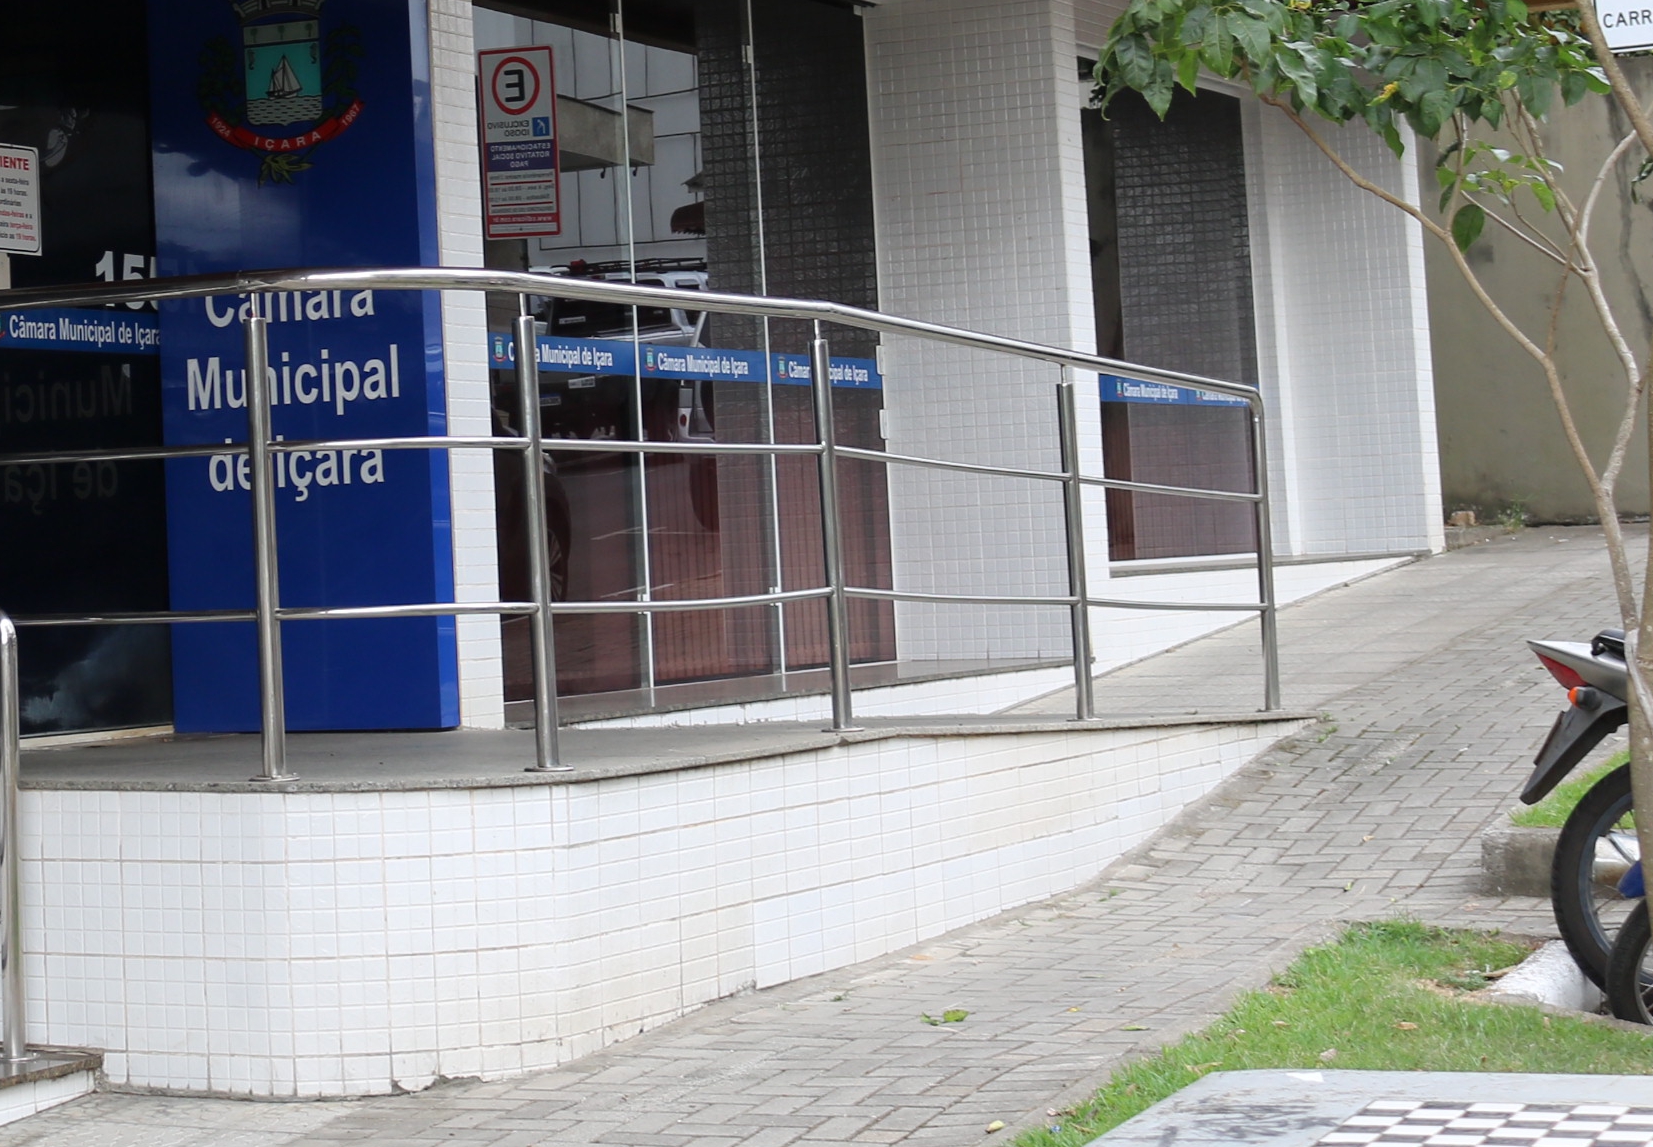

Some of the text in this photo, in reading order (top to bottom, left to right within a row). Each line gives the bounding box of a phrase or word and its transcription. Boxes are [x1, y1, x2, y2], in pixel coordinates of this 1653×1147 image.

[1603, 9, 1653, 28] CARR
[211, 117, 231, 137] 1924
[341, 104, 360, 126] 1967
[254, 131, 321, 151] IÇARA
[95, 250, 159, 310] 15
[9, 314, 57, 341] Câmara
[59, 317, 116, 348] Municipal
[117, 321, 133, 344] de
[541, 344, 581, 369] Municipal
[582, 346, 593, 366] de
[593, 347, 613, 371] Içara
[658, 352, 686, 372] Câmara
[687, 354, 720, 377] Municipal
[721, 356, 730, 374] de
[788, 361, 810, 379] Câmar
[186, 343, 400, 416] Municipal
[275, 434, 385, 502] Içara
